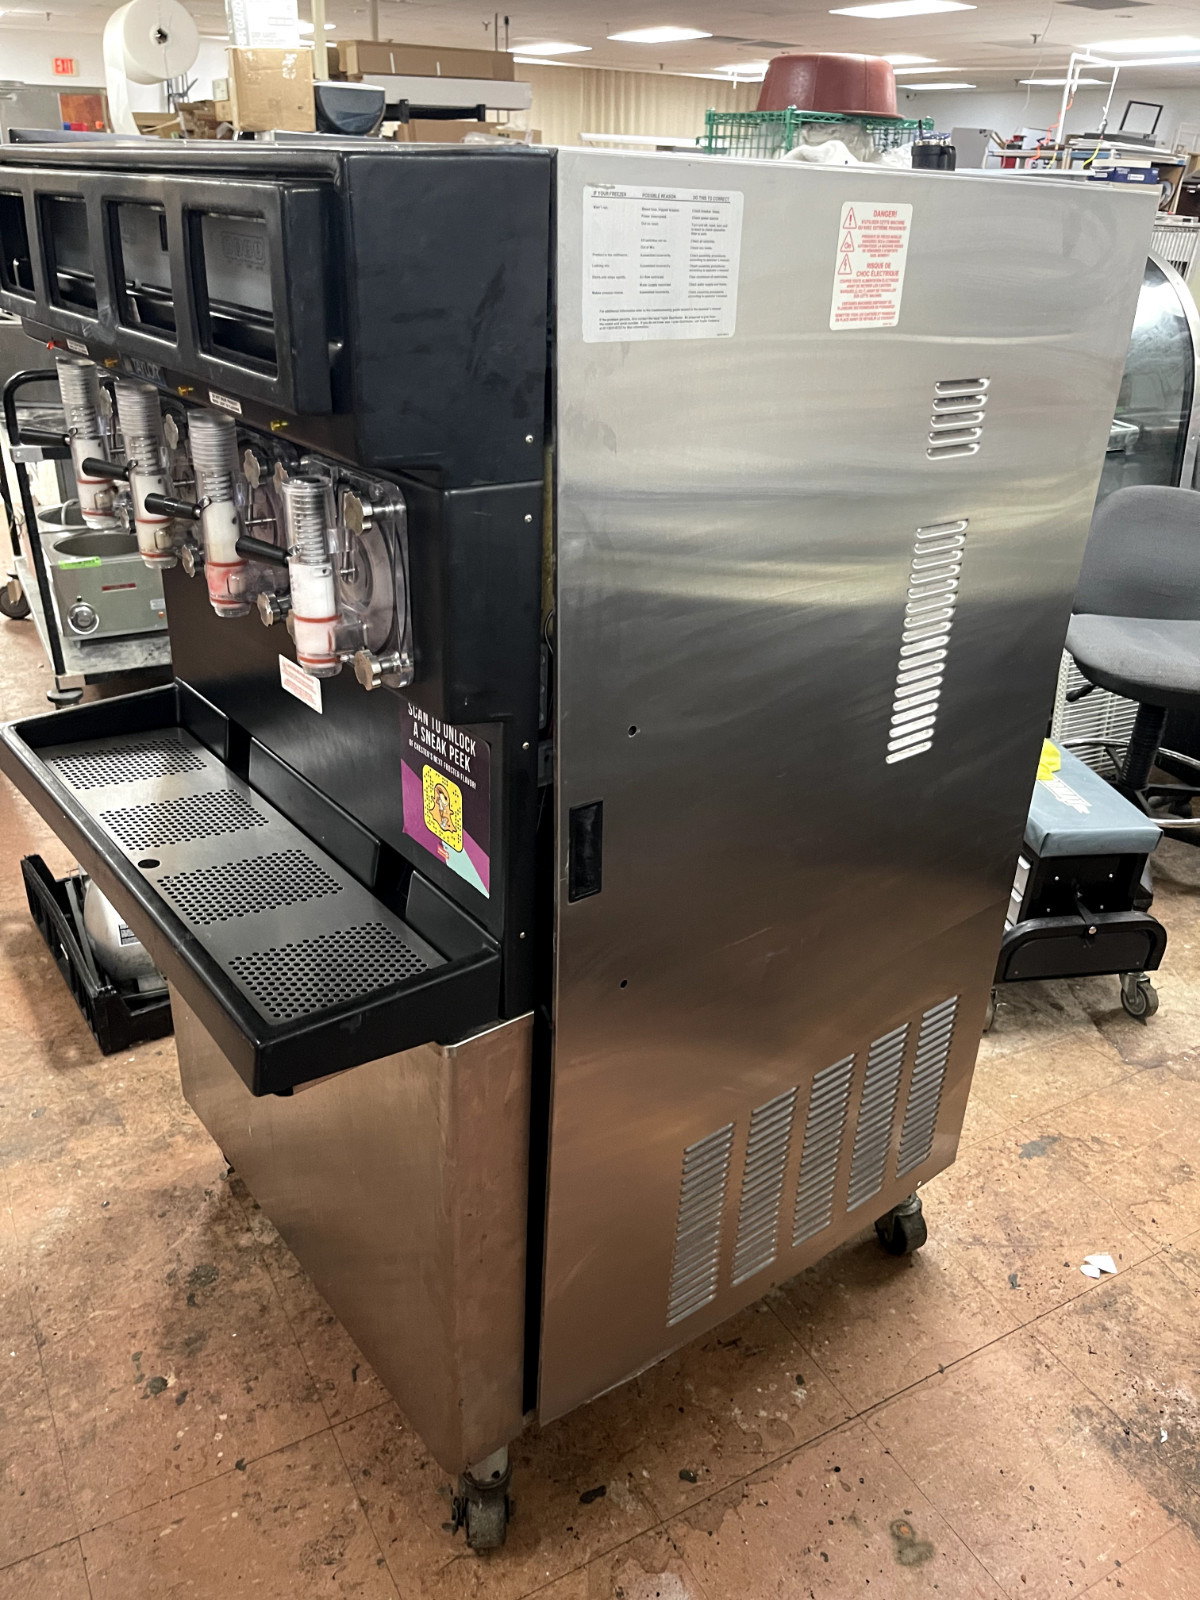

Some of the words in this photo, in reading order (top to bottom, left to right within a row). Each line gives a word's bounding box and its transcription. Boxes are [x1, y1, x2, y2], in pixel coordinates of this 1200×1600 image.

[55, 58, 74, 74] EXIT
[873, 210, 898, 218] DANGER!
[131, 358, 161, 381] TAYLOR
[408, 702, 429, 726] SCAN
[443, 723, 476, 757] UNLOCK
[413, 721, 419, 739] A
[420, 726, 447, 757] SNEAK
[449, 744, 471, 773] PEEK
[433, 755, 443, 767] NEXT
